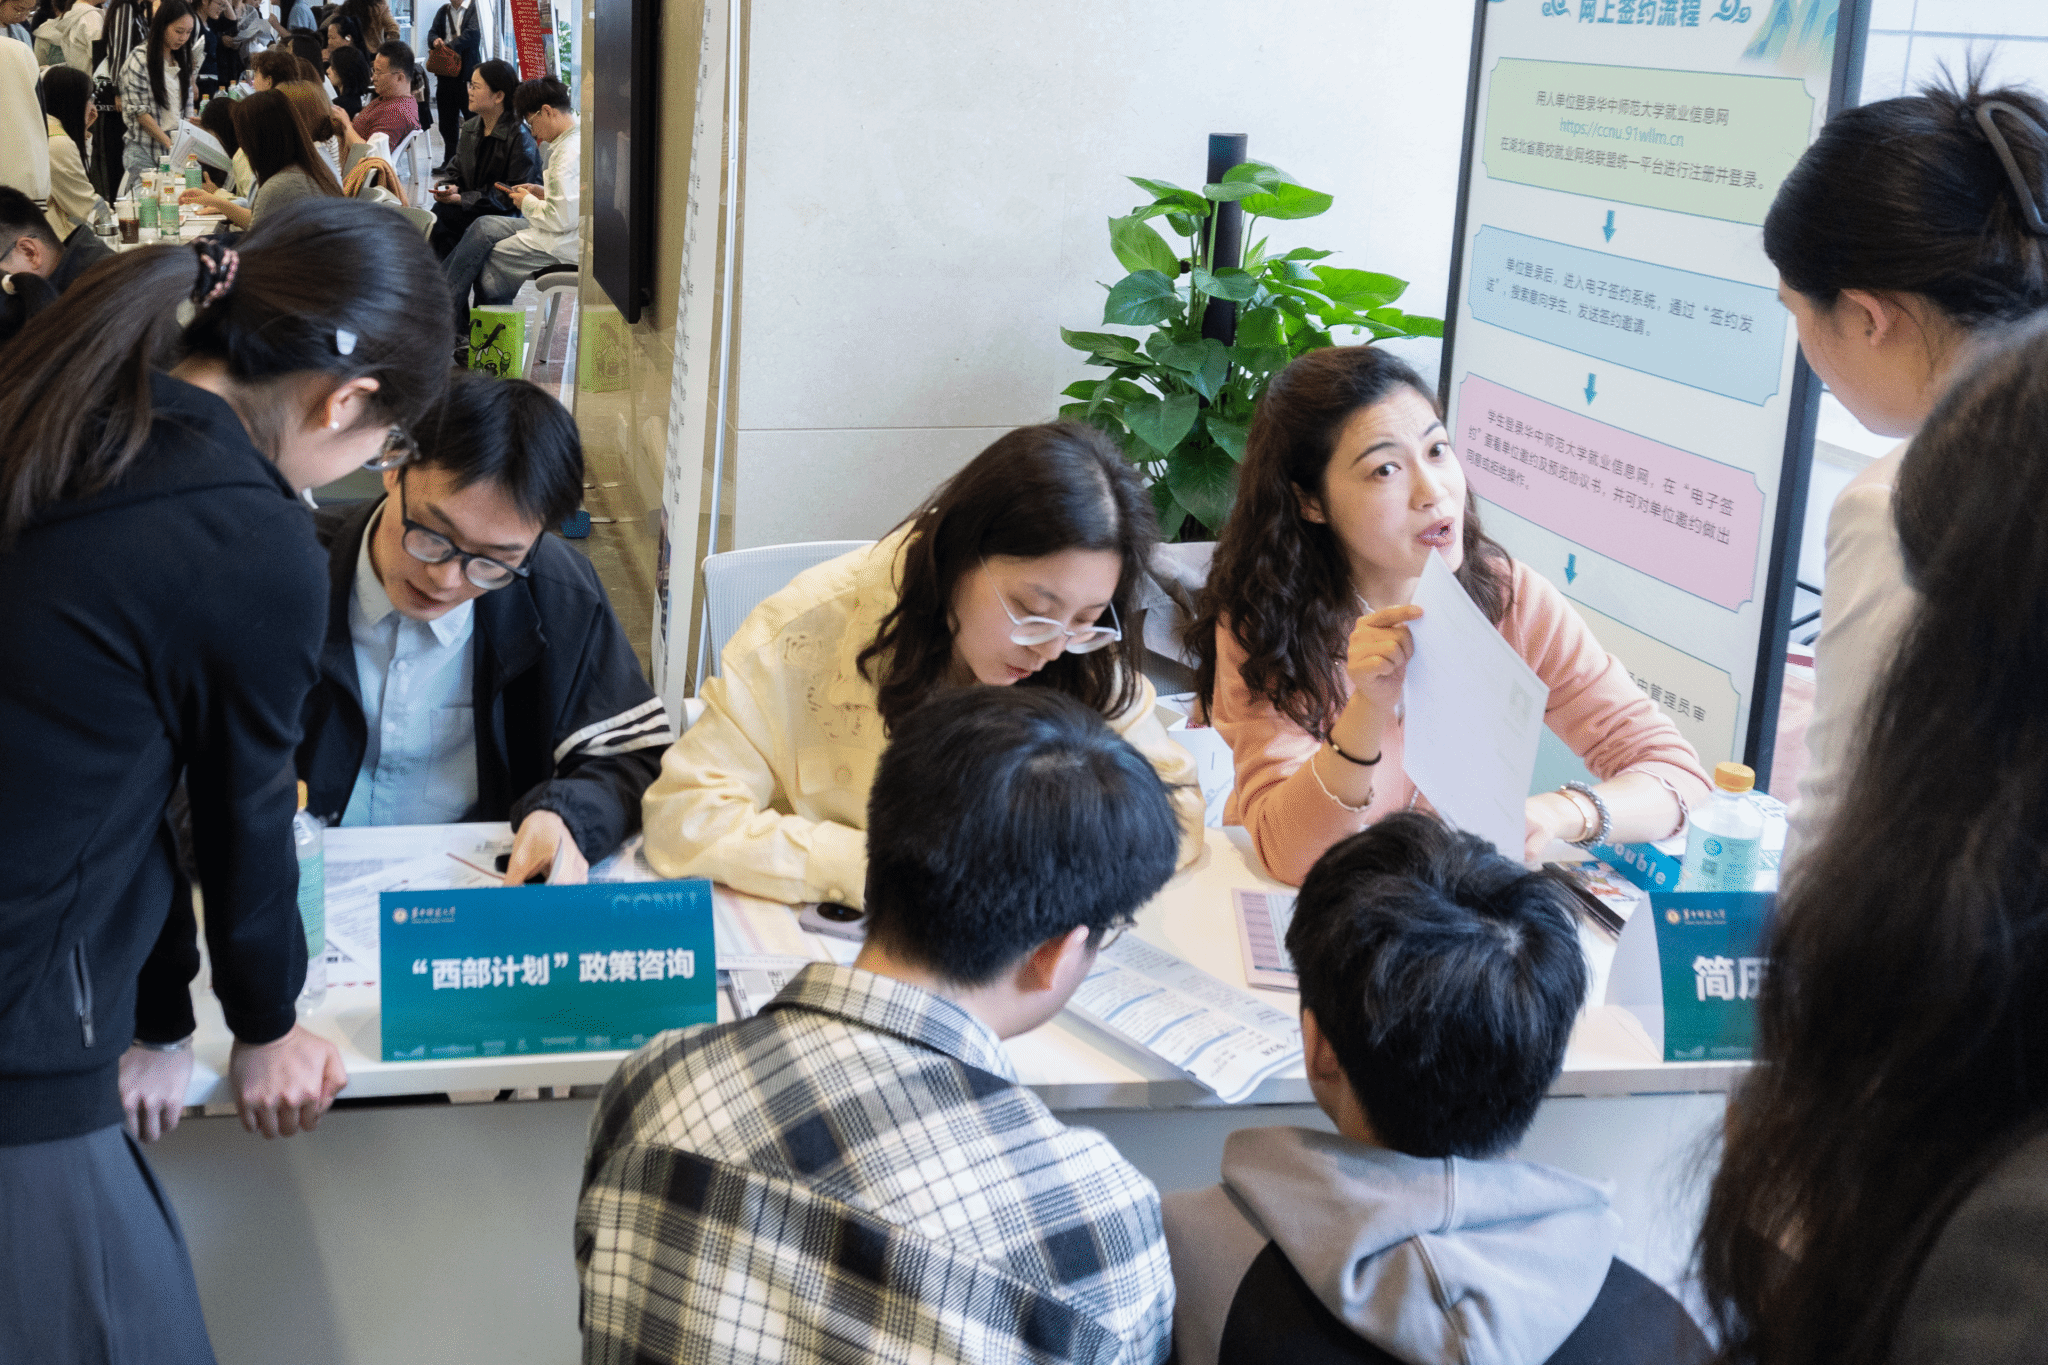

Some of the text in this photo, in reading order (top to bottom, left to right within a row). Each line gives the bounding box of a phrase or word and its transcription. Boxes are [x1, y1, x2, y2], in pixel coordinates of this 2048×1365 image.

[1578, 0, 1700, 27] 网上签约流程
[1536, 90, 1730, 126] 用人单位登录华中师范大学就业信息网
[1559, 117, 1685, 147] https://ccnu.91wllm.cn
[1500, 136, 1765, 189] 在湖北省高校就业网络联盟统一平台进行注册并登录。
[1604, 841, 1666, 885] ouble
